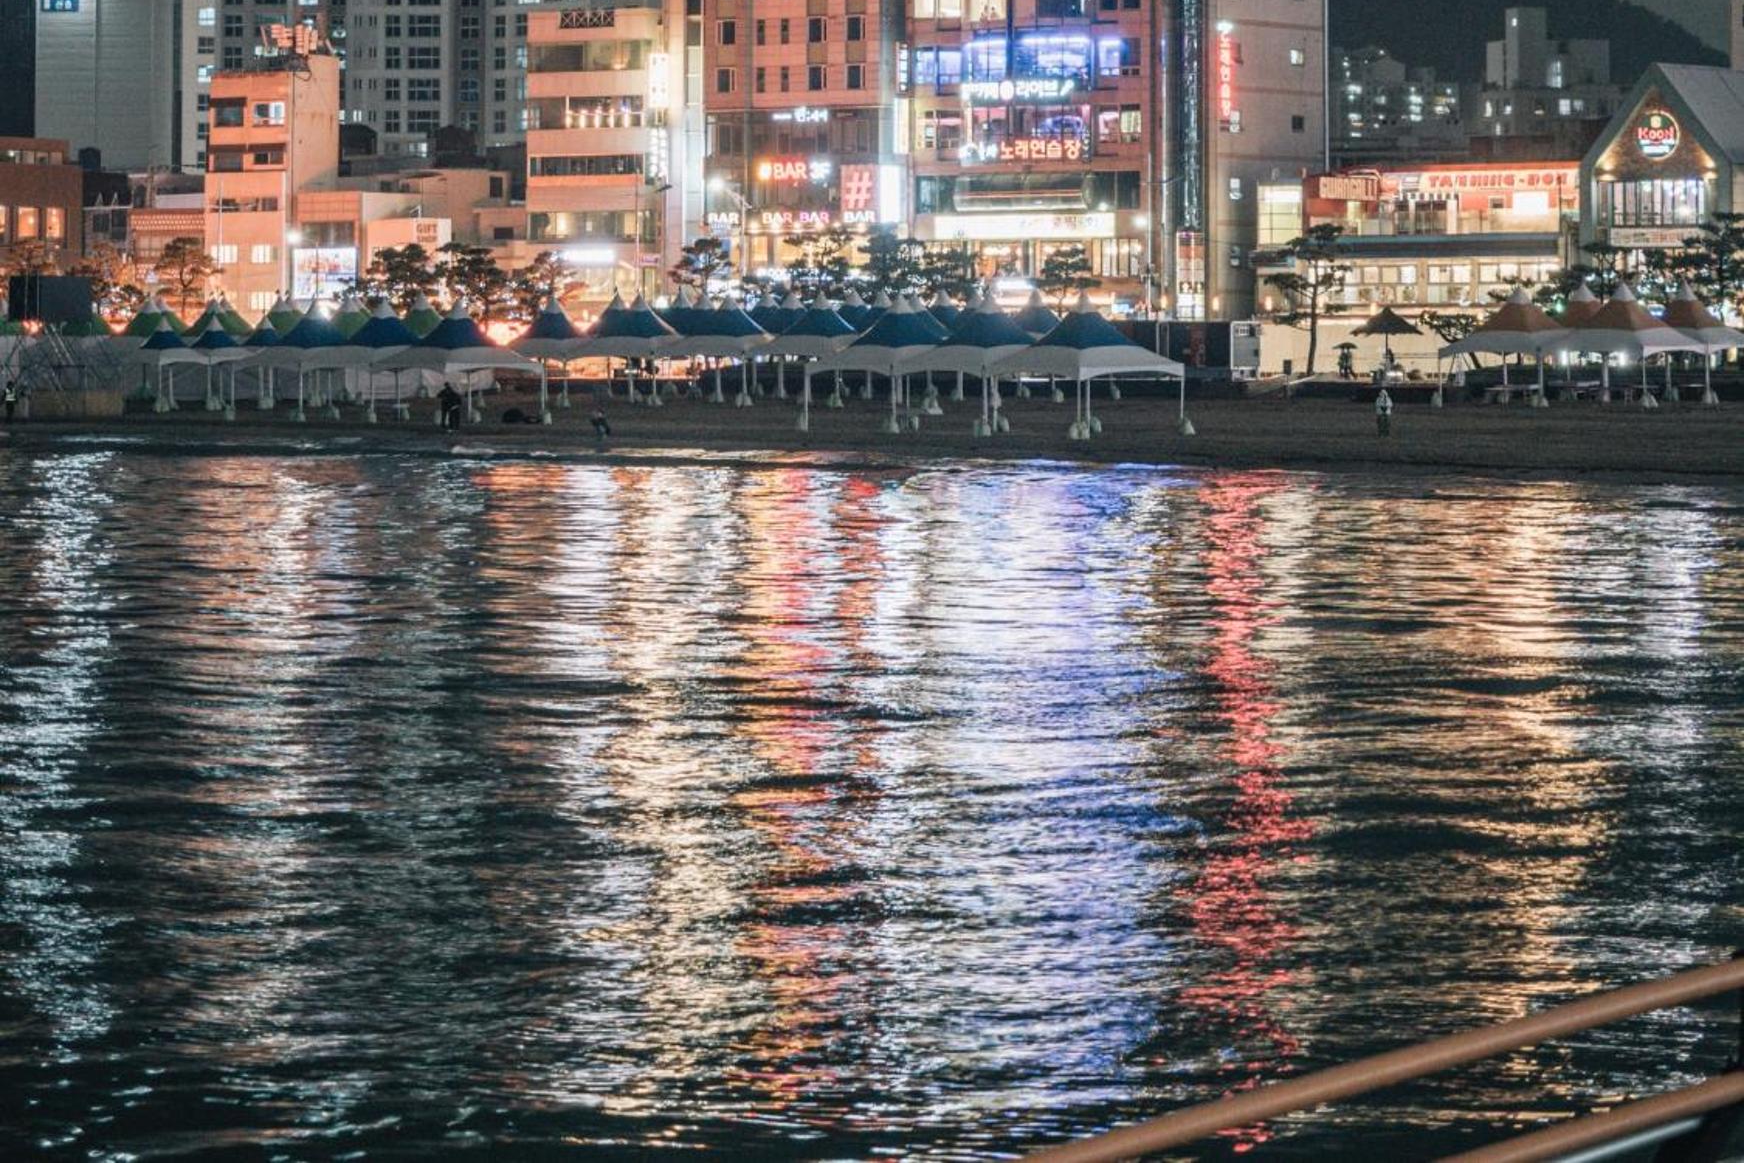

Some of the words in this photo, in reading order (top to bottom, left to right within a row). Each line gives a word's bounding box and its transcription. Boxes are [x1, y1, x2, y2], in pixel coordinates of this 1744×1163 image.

[1015, 80, 1059, 98] 라이브
[1001, 139, 1081, 160] 노래연습장
[773, 161, 808, 179] BAR
[707, 212, 740, 224] BAR
[762, 212, 793, 224] BAR
[800, 211, 830, 224] BAR
[844, 210, 876, 223] BAR
[416, 223, 437, 234] GIFT
